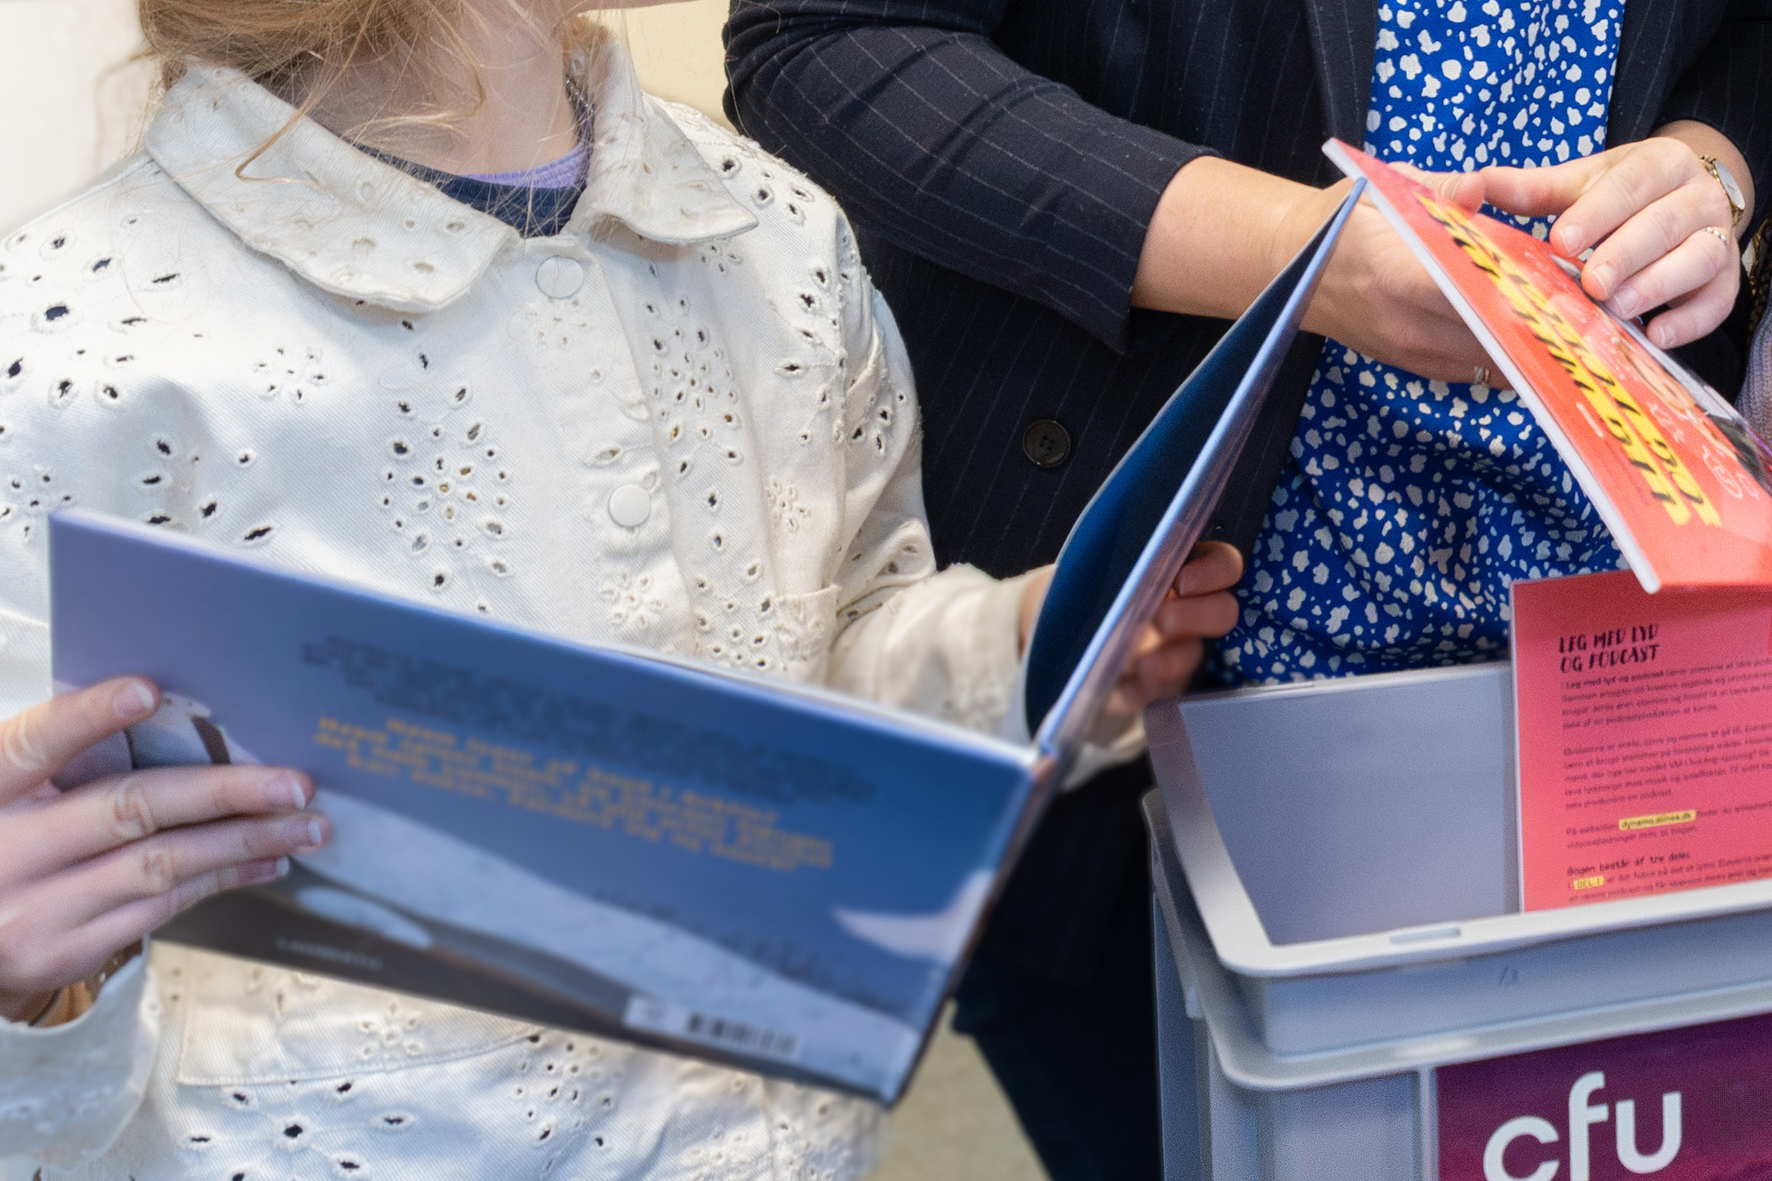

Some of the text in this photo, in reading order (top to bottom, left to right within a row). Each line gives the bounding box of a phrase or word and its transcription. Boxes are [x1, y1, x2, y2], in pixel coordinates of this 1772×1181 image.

[1559, 624, 1658, 653] LEG MED LYD
[1560, 656, 1582, 673] OG
[1588, 644, 1659, 669] PODCAST
[1483, 1071, 1682, 1181] cfu
